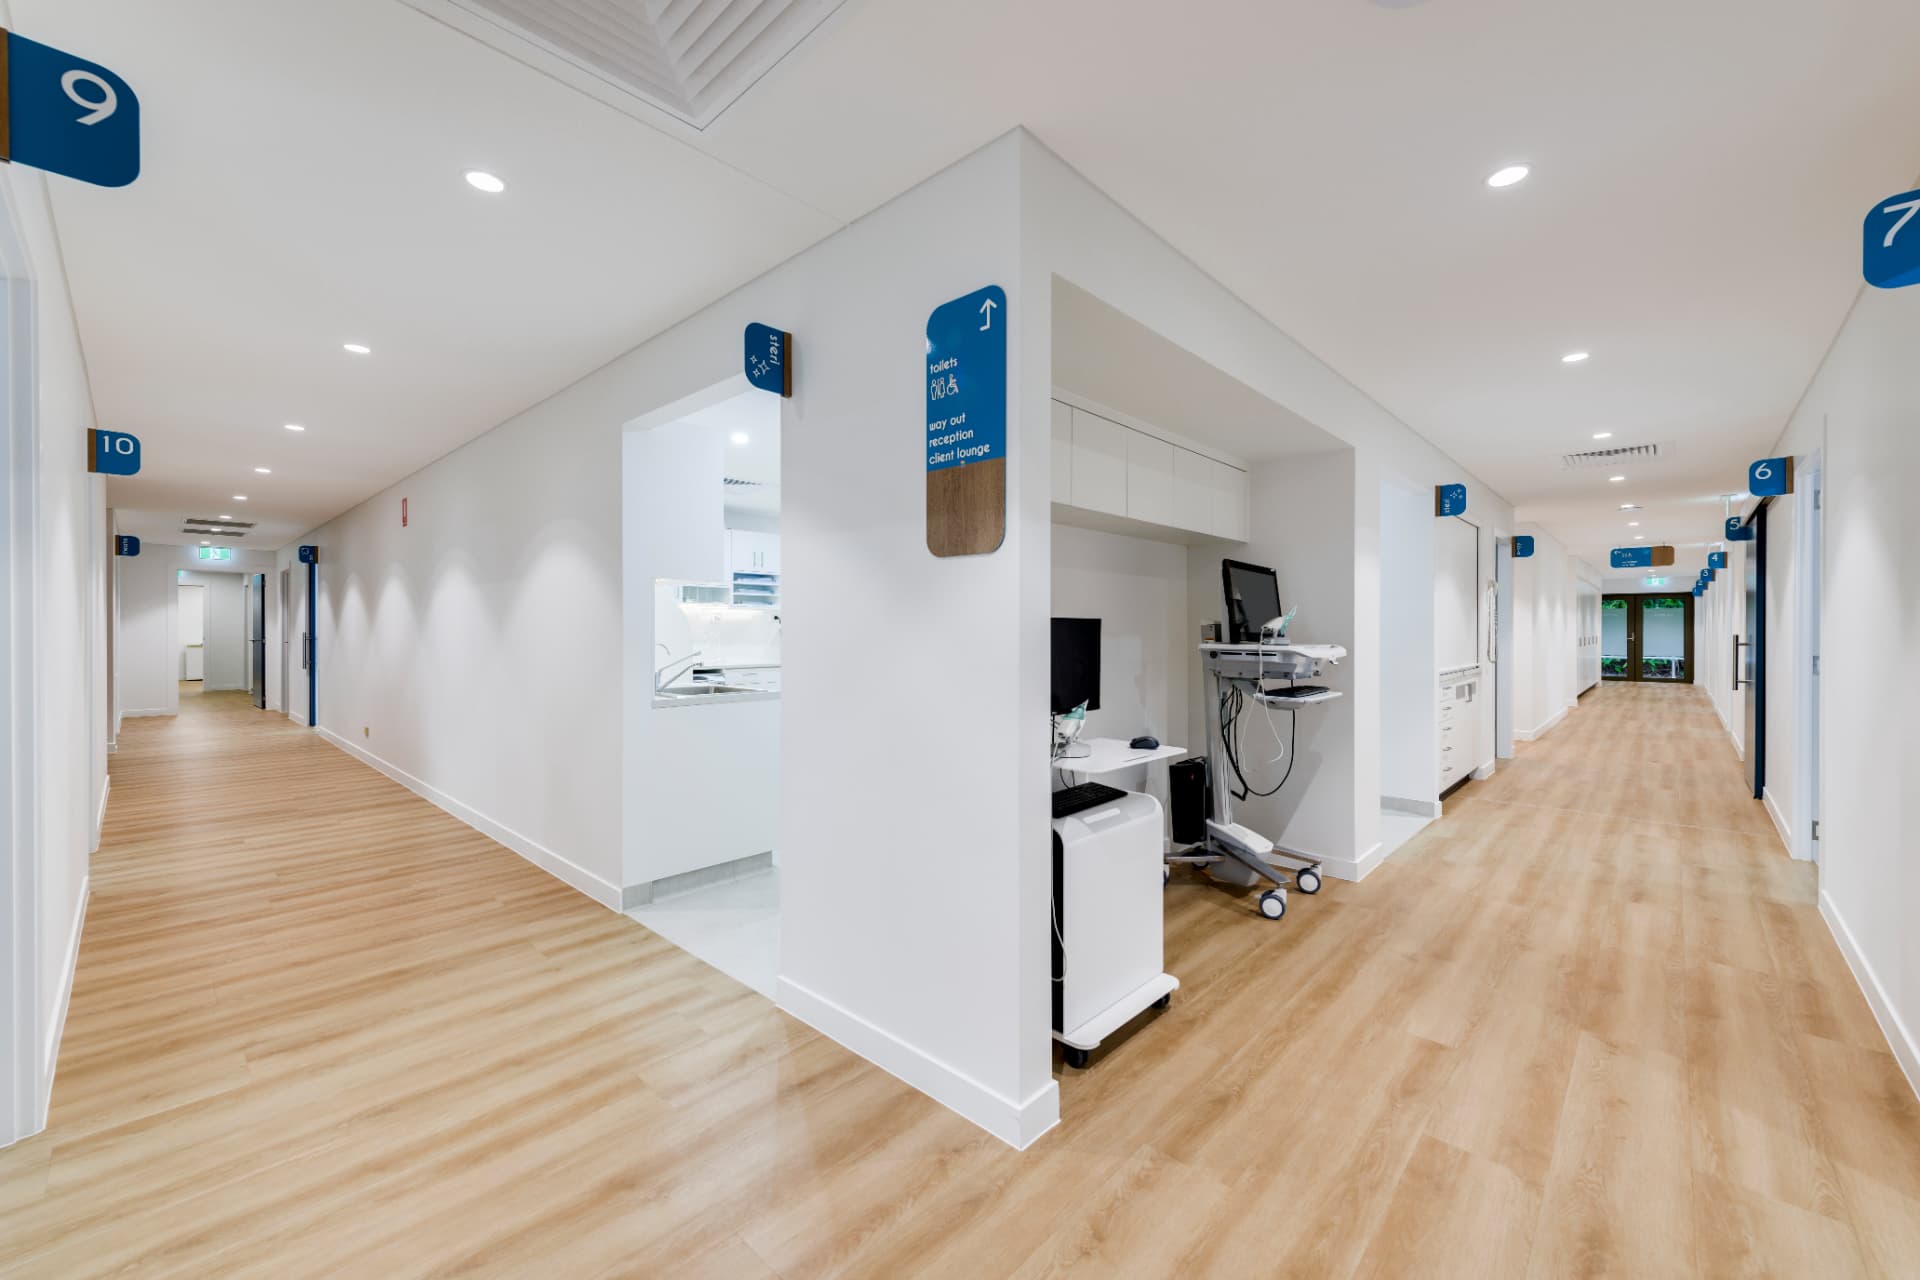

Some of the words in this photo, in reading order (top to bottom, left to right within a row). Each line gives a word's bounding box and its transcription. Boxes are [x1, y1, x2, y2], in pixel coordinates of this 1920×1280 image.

[60, 69, 118, 126] 9
[1883, 198, 1920, 248] 7
[769, 334, 781, 366] steri
[930, 357, 958, 374] toilets
[929, 418, 947, 432] way
[950, 412, 966, 426] out
[102, 434, 135, 455] 10
[929, 429, 974, 448] reception
[929, 450, 954, 465] client
[957, 443, 991, 459] lounge
[1754, 462, 1772, 480] 6
[1729, 519, 1741, 530] 5
[1711, 553, 1720, 562] 4
